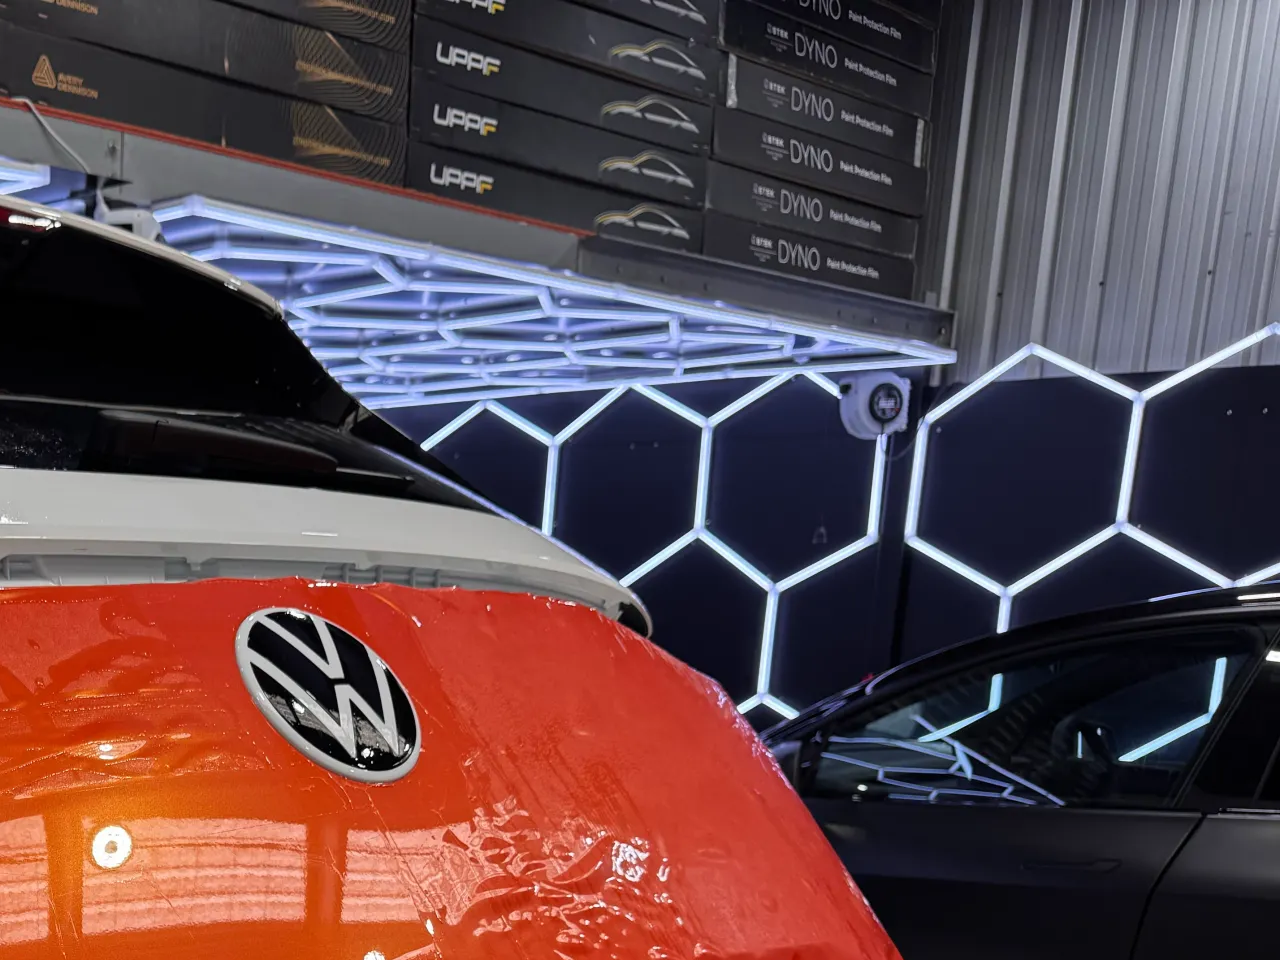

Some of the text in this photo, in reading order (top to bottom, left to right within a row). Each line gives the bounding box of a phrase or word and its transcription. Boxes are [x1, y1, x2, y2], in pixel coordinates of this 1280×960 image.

[863, 15, 890, 35] Protection
[794, 32, 838, 68] DYNO
[859, 63, 885, 82] Protection
[791, 86, 834, 121] DYNO
[856, 115, 882, 132] Protection
[790, 139, 833, 172] DYNO
[854, 164, 880, 181] Protection
[780, 189, 823, 221] DYNO
[844, 213, 870, 229] Protection
[778, 239, 820, 271] DYNO
[841, 261, 867, 277] Protection
